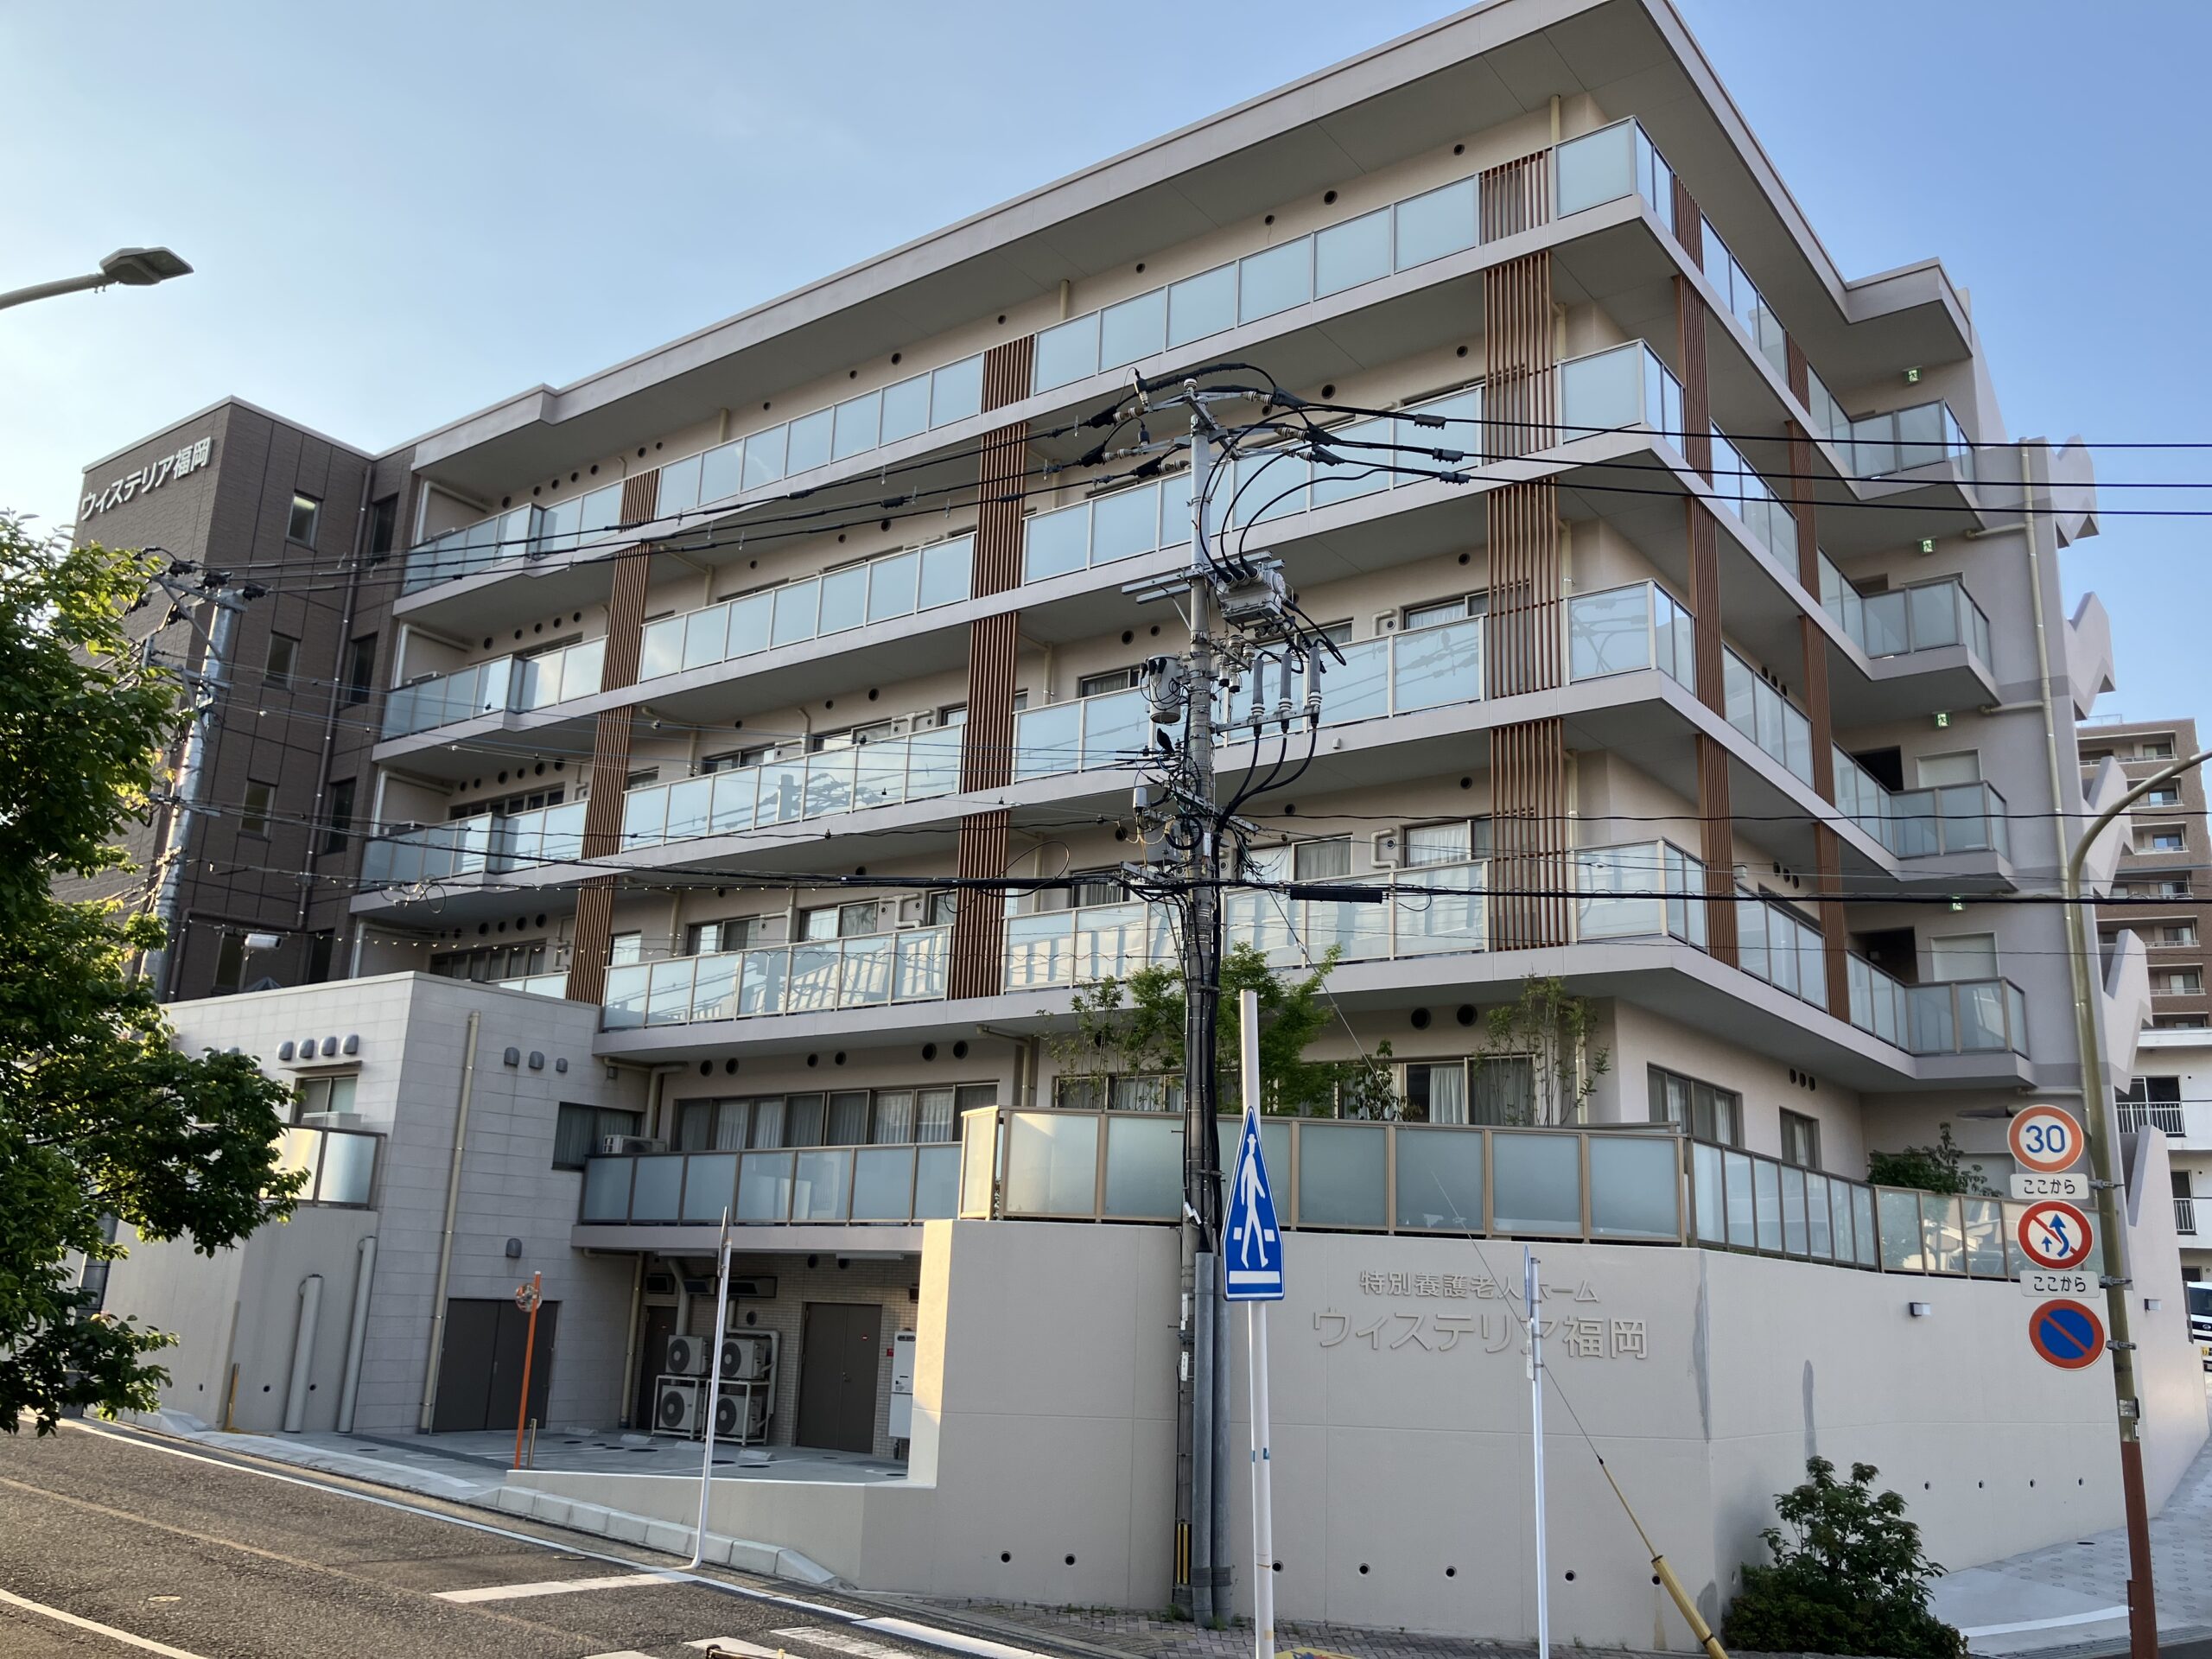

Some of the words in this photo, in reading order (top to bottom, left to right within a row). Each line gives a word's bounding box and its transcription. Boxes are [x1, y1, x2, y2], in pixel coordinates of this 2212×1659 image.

[81, 436, 211, 520] ウィステリア福岡
[2025, 1124, 2065, 1154] 30
[2024, 1179, 2075, 1195] ここから
[2033, 1275, 2087, 1293] ここから
[1313, 1307, 1648, 1360] ウィステリア福岡
